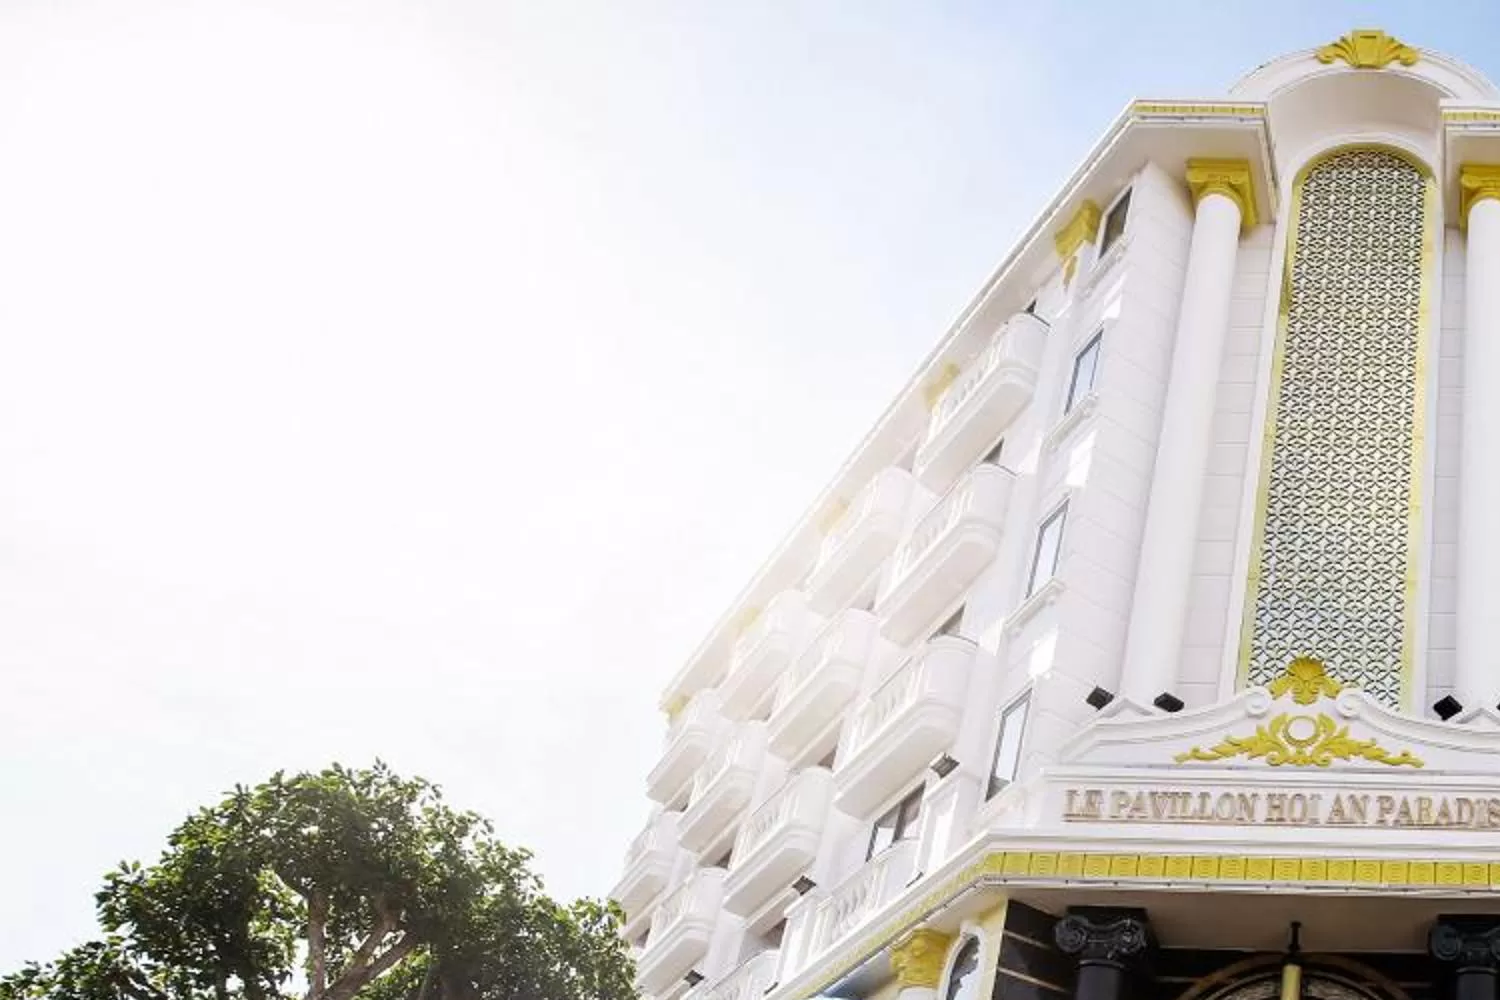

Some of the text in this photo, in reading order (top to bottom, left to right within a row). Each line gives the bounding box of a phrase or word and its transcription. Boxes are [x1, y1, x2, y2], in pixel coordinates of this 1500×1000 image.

[1064, 790, 1103, 822] LE
[1110, 791, 1258, 823] PAVILLON
[1264, 793, 1322, 825] HOI
[1325, 793, 1370, 826] AN
